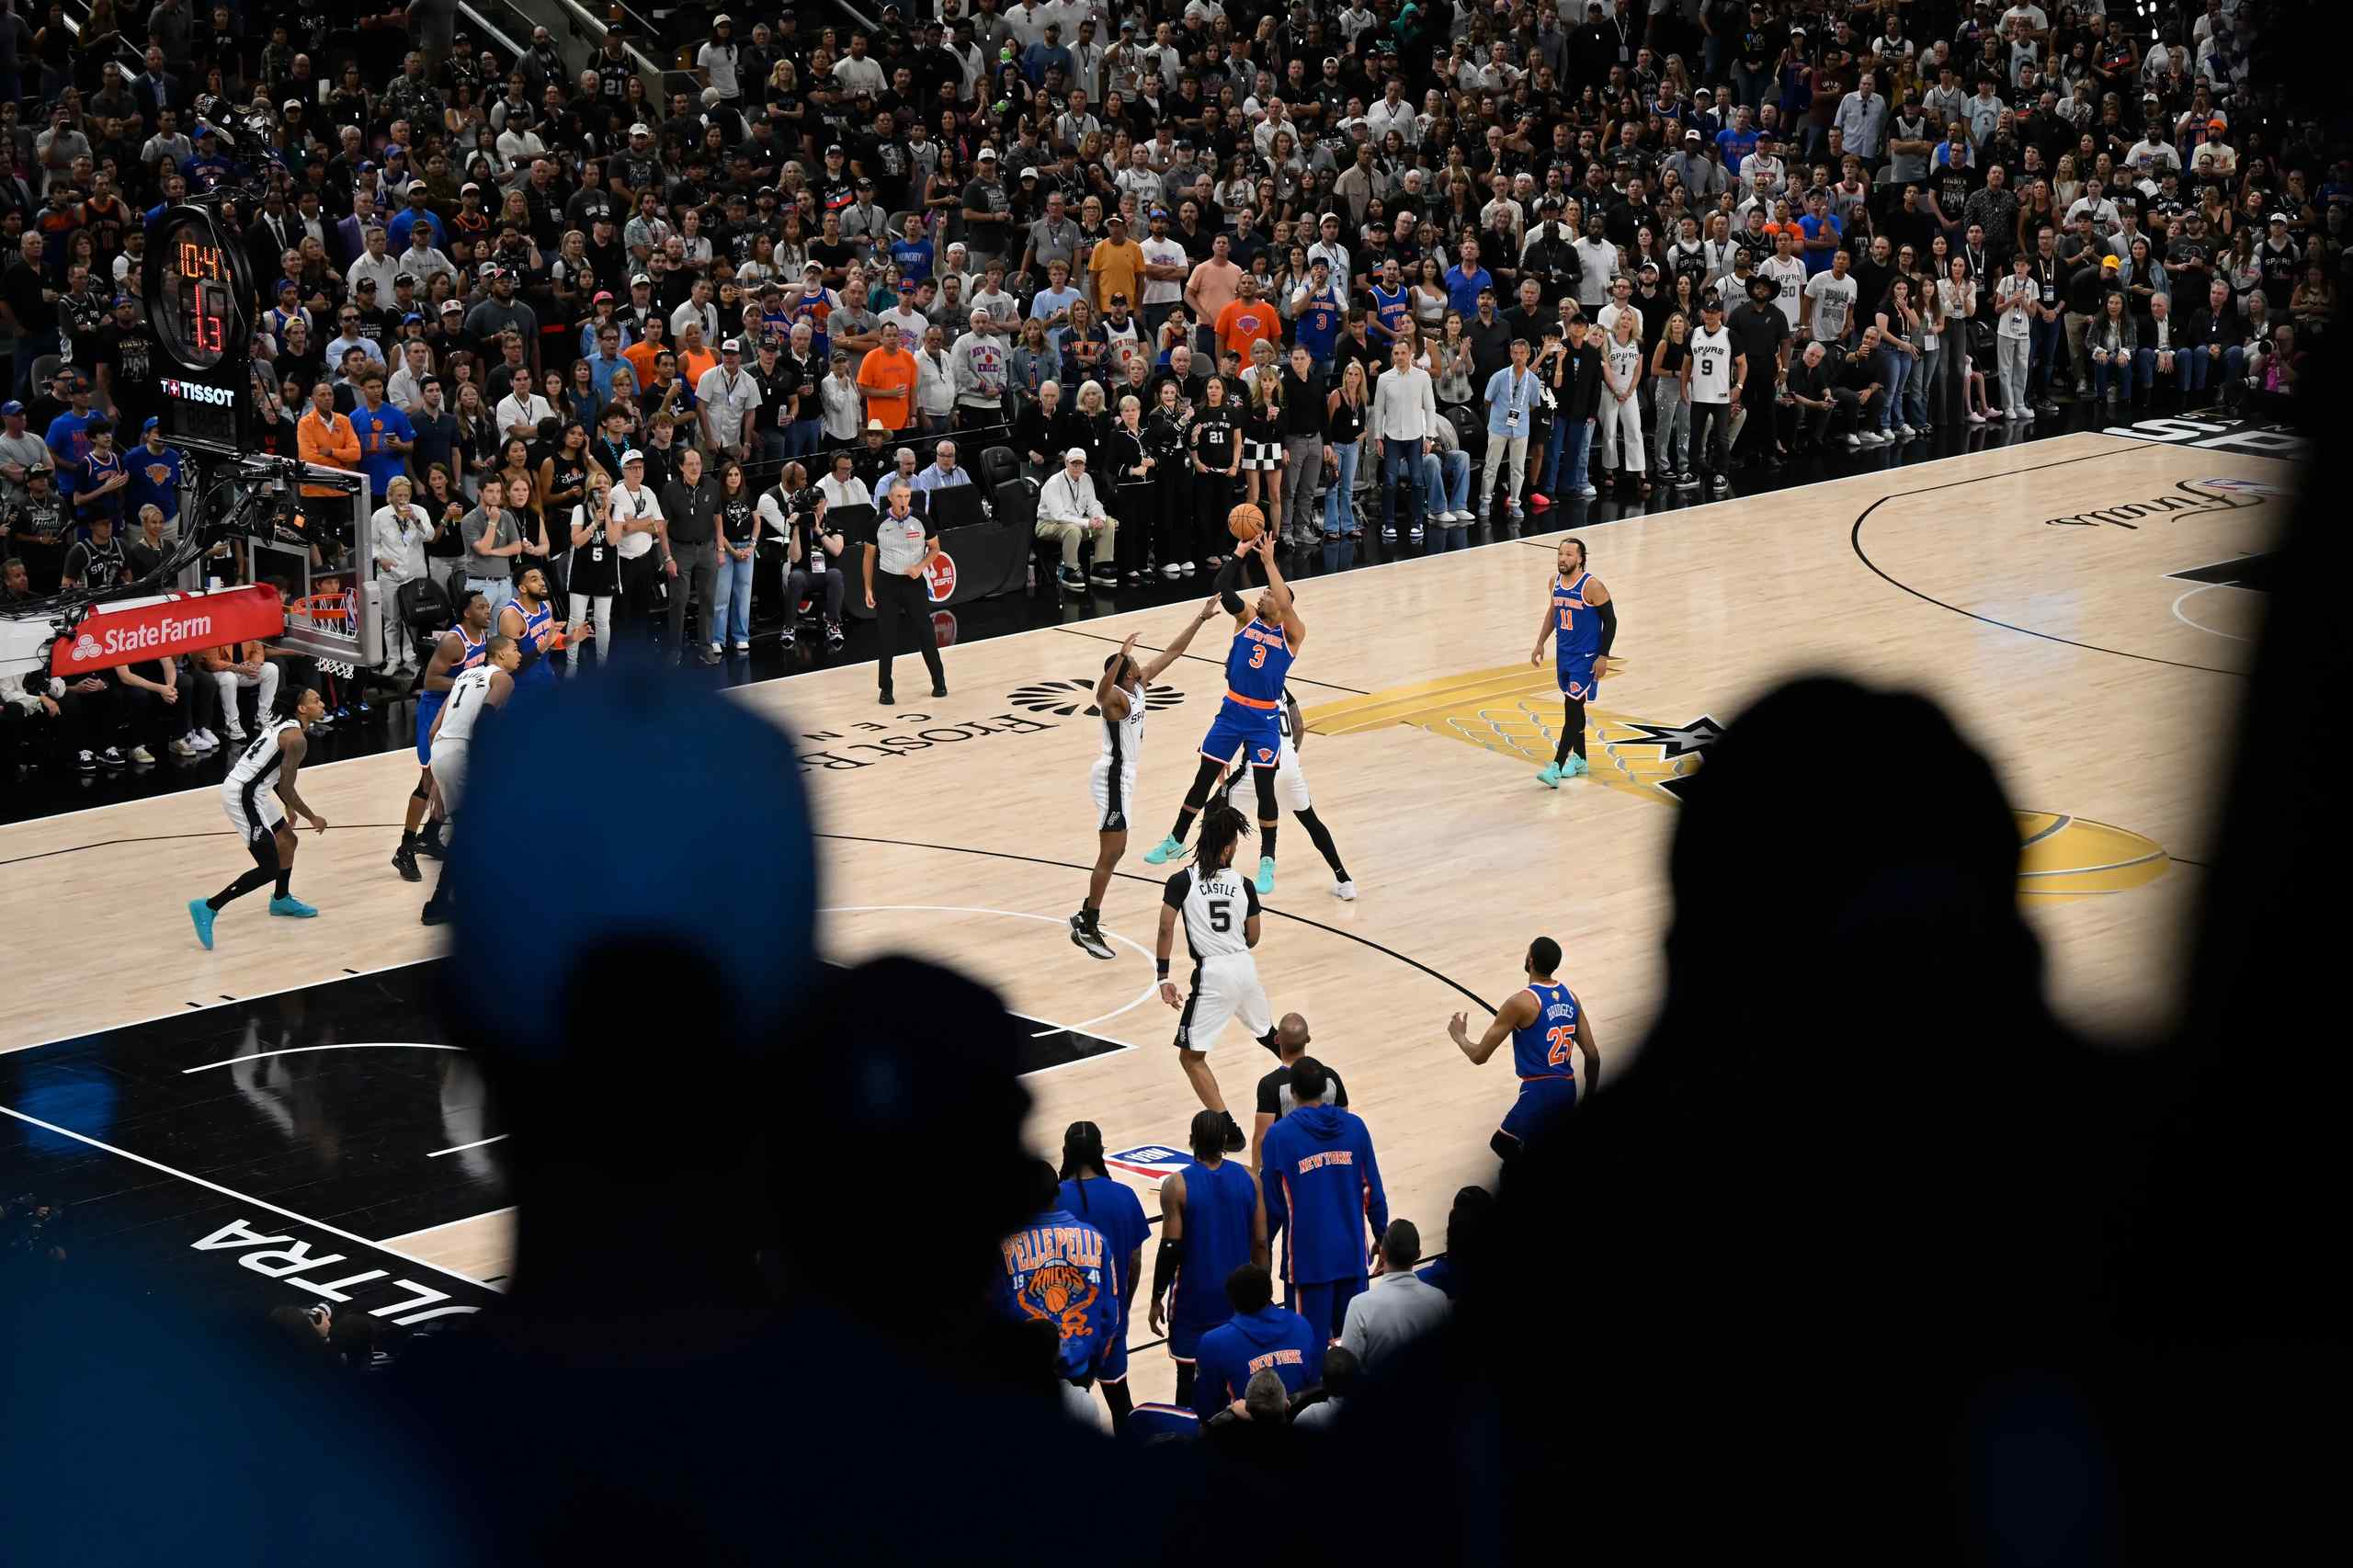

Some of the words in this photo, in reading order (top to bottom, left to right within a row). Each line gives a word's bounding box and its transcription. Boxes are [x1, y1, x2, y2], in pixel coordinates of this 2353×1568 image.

[605, 79, 622, 95] 21
[1316, 313, 1327, 331] 3
[1693, 347, 1725, 357] SPURS
[1620, 364, 1625, 376] 1
[1702, 359, 1713, 375] 9
[180, 381, 234, 407] TISSOT
[1209, 431, 1225, 444] 21
[2046, 479, 2267, 530] Finals
[593, 546, 603, 562] 5
[933, 578, 953, 587] ESPN
[1560, 608, 1574, 631] 11
[105, 623, 159, 655] State
[160, 616, 211, 644] Farm
[1248, 643, 1267, 669] 3
[451, 684, 468, 709] 1
[246, 736, 268, 760] 4
[1199, 882, 1237, 898] CASTLE
[1209, 900, 1231, 933] 5
[1546, 1003, 1574, 1022] BRIDGES
[1546, 1024, 1576, 1067] 25
[1126, 1146, 1176, 1163] NBA
[1298, 1153, 1324, 1175] NEW
[1324, 1151, 1354, 1167] YORK
[1013, 1274, 1025, 1290] 19
[1029, 1265, 1086, 1298] KNICKS
[1248, 1354, 1273, 1375] NEW
[1273, 1349, 1303, 1368] YORK
